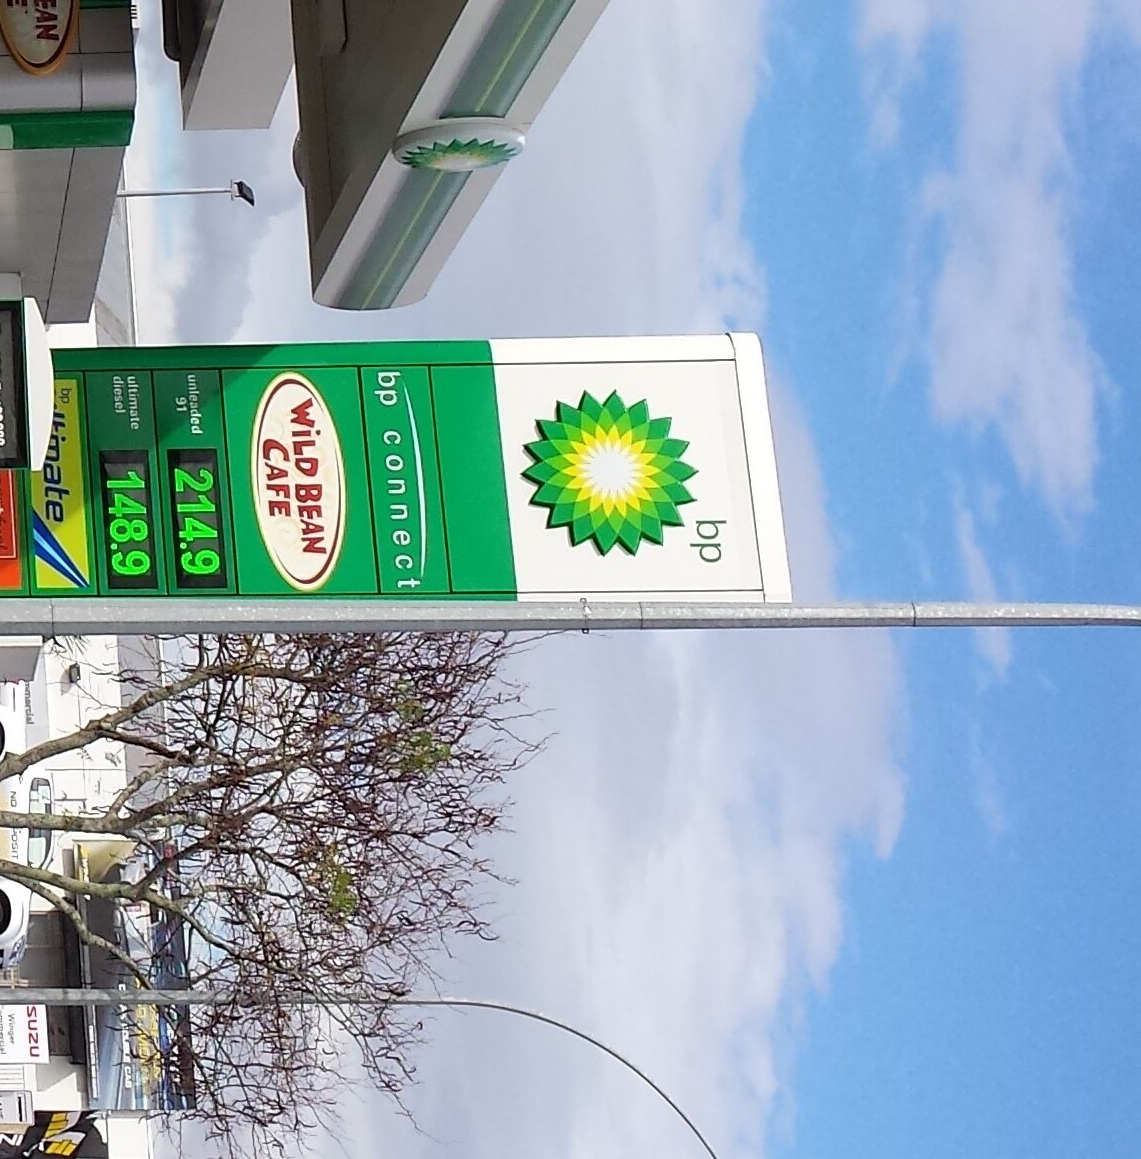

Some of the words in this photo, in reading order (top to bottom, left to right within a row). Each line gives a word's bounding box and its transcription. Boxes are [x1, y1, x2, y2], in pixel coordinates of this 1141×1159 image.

[60, 388, 72, 404] bp
[112, 376, 126, 413] diesel
[127, 376, 141, 430] ultimate
[175, 397, 188, 412] 91
[188, 374, 203, 434] unleaded
[373, 371, 402, 406] bp
[263, 439, 291, 517] CAFE
[106, 471, 151, 576] 148.9
[174, 468, 220, 575] 214.9
[294, 483, 327, 554] BEAN
[383, 430, 420, 588] connect
[691, 520, 726, 563] bp
[10, 791, 17, 807] NO
[7, 1014, 15, 1044] Winger
[27, 1006, 40, 1057] SUZU
